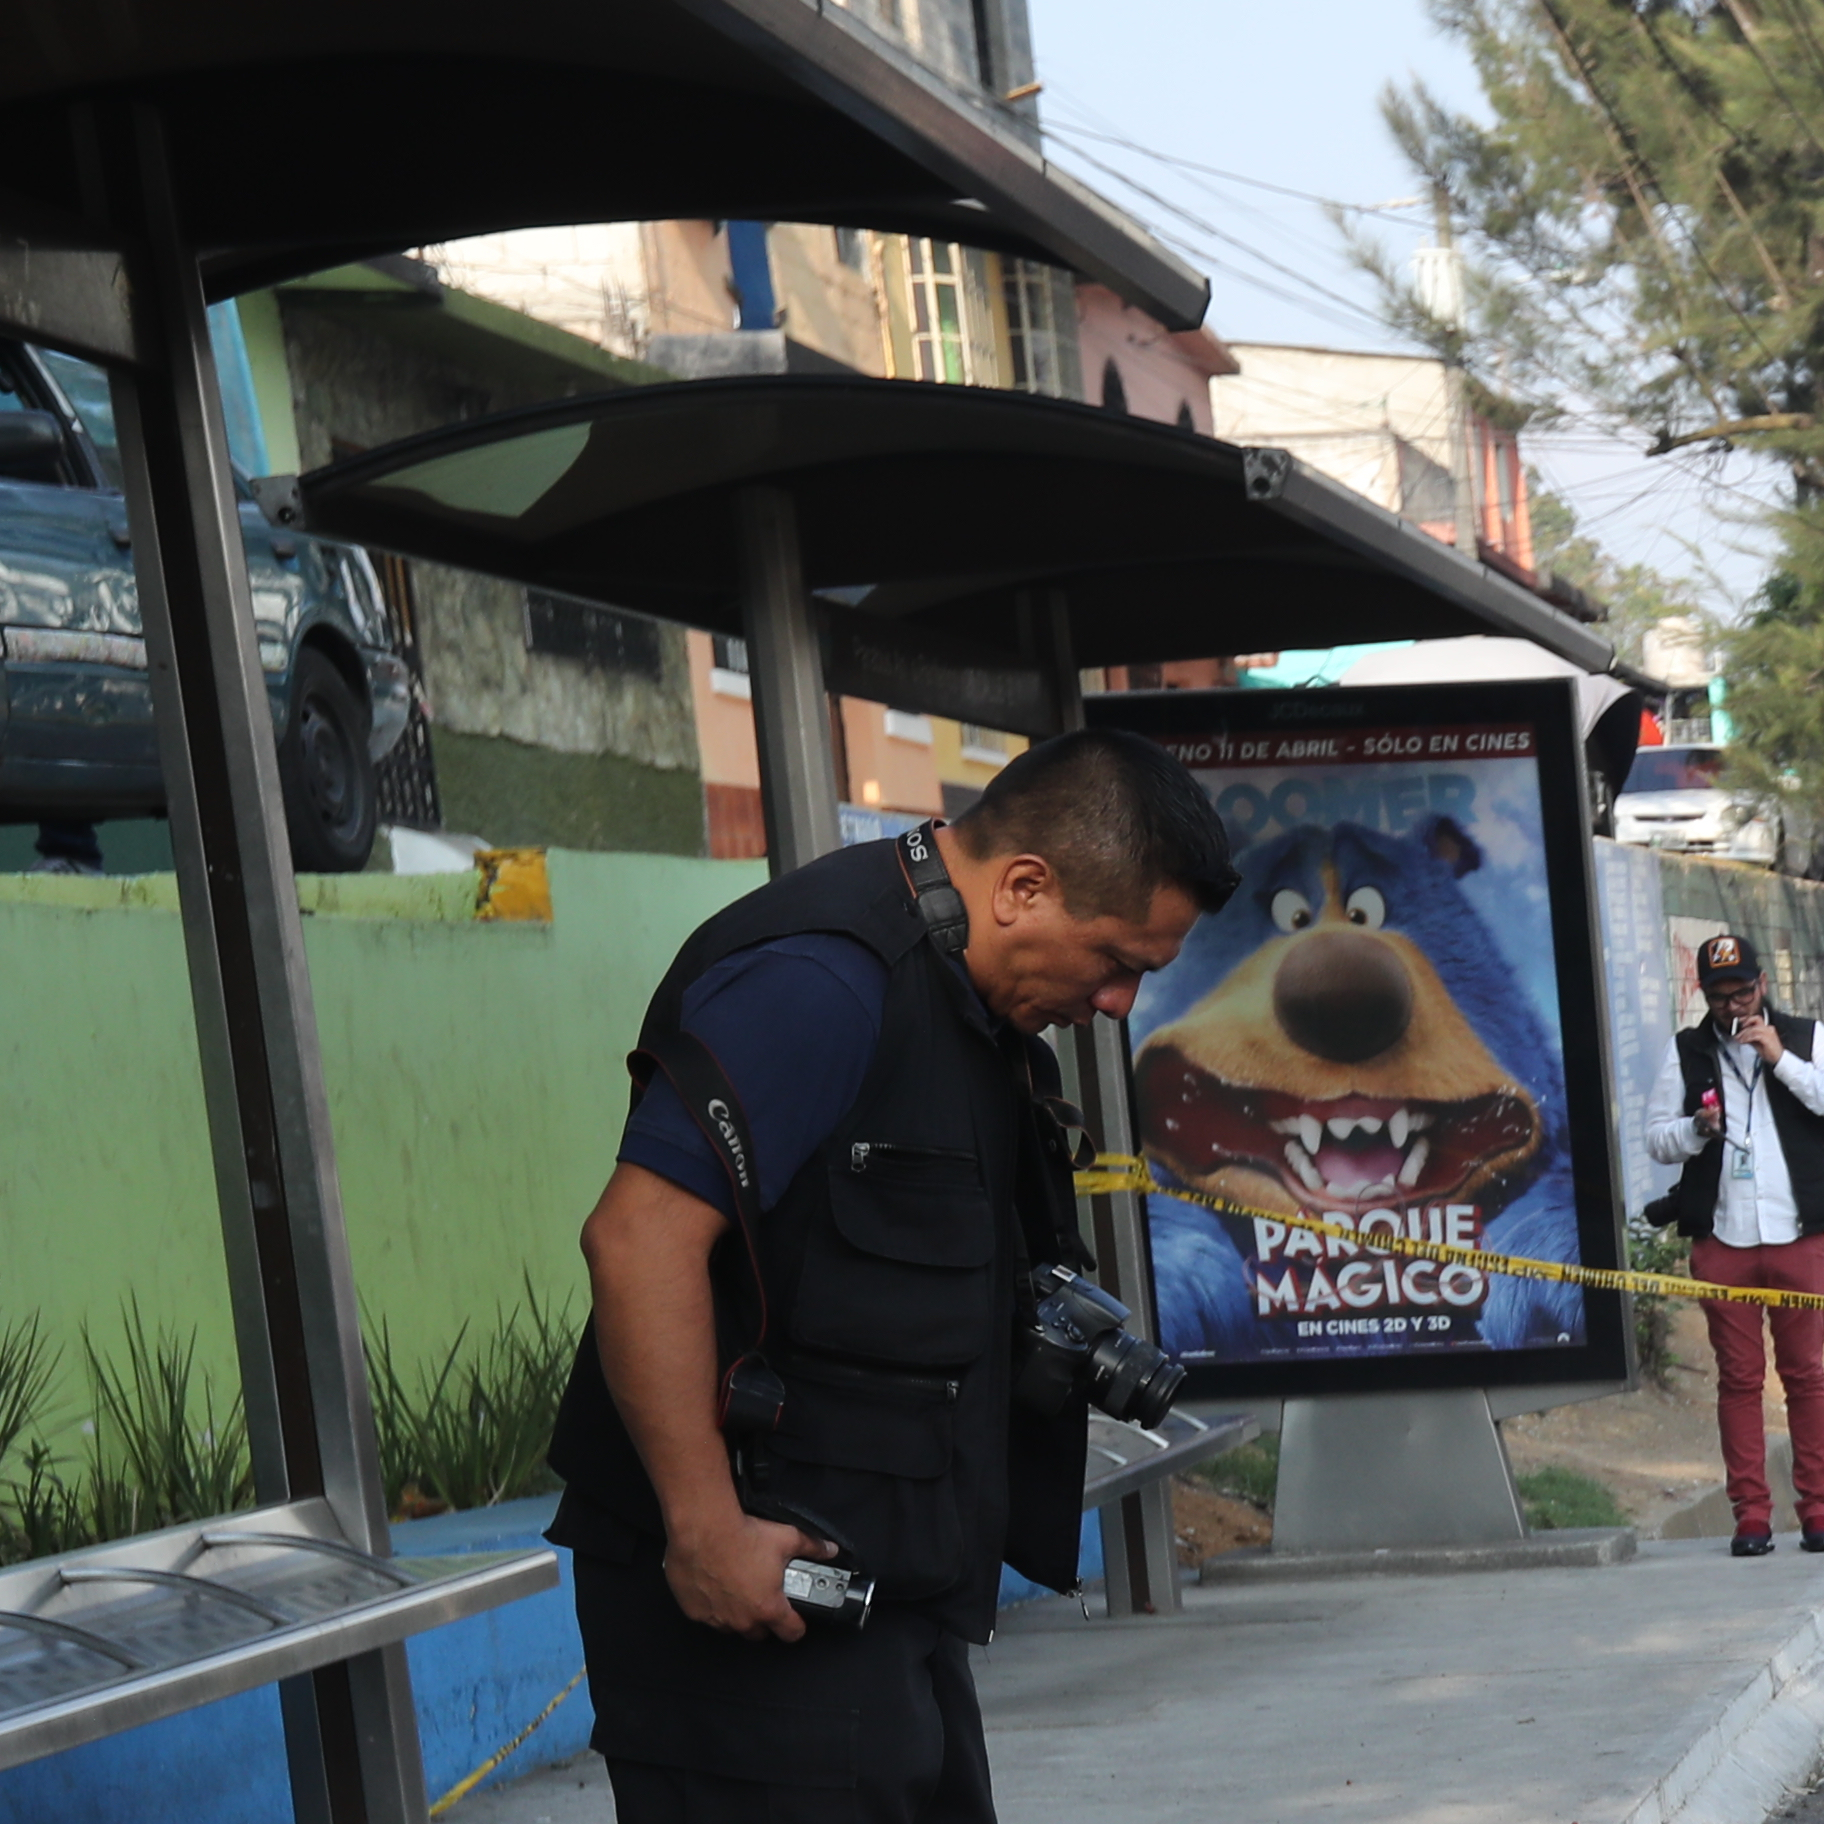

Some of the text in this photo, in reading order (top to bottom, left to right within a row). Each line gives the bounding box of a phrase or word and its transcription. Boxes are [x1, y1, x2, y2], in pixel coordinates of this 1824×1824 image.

[1240, 741, 1269, 760] DE
[1276, 739, 1339, 759] ABRIL
[1363, 733, 1421, 757] SÓLO
[1429, 735, 1460, 754] EN
[1465, 731, 1531, 752] CINES
[1204, 773, 1477, 836] OOMER
[708, 1098, 750, 1188] Canon
[1253, 1205, 1477, 1262] PARQUE
[1256, 1256, 1484, 1316] MÁGICO
[1298, 1315, 1451, 1337] EN CINES 2D Y 3D
